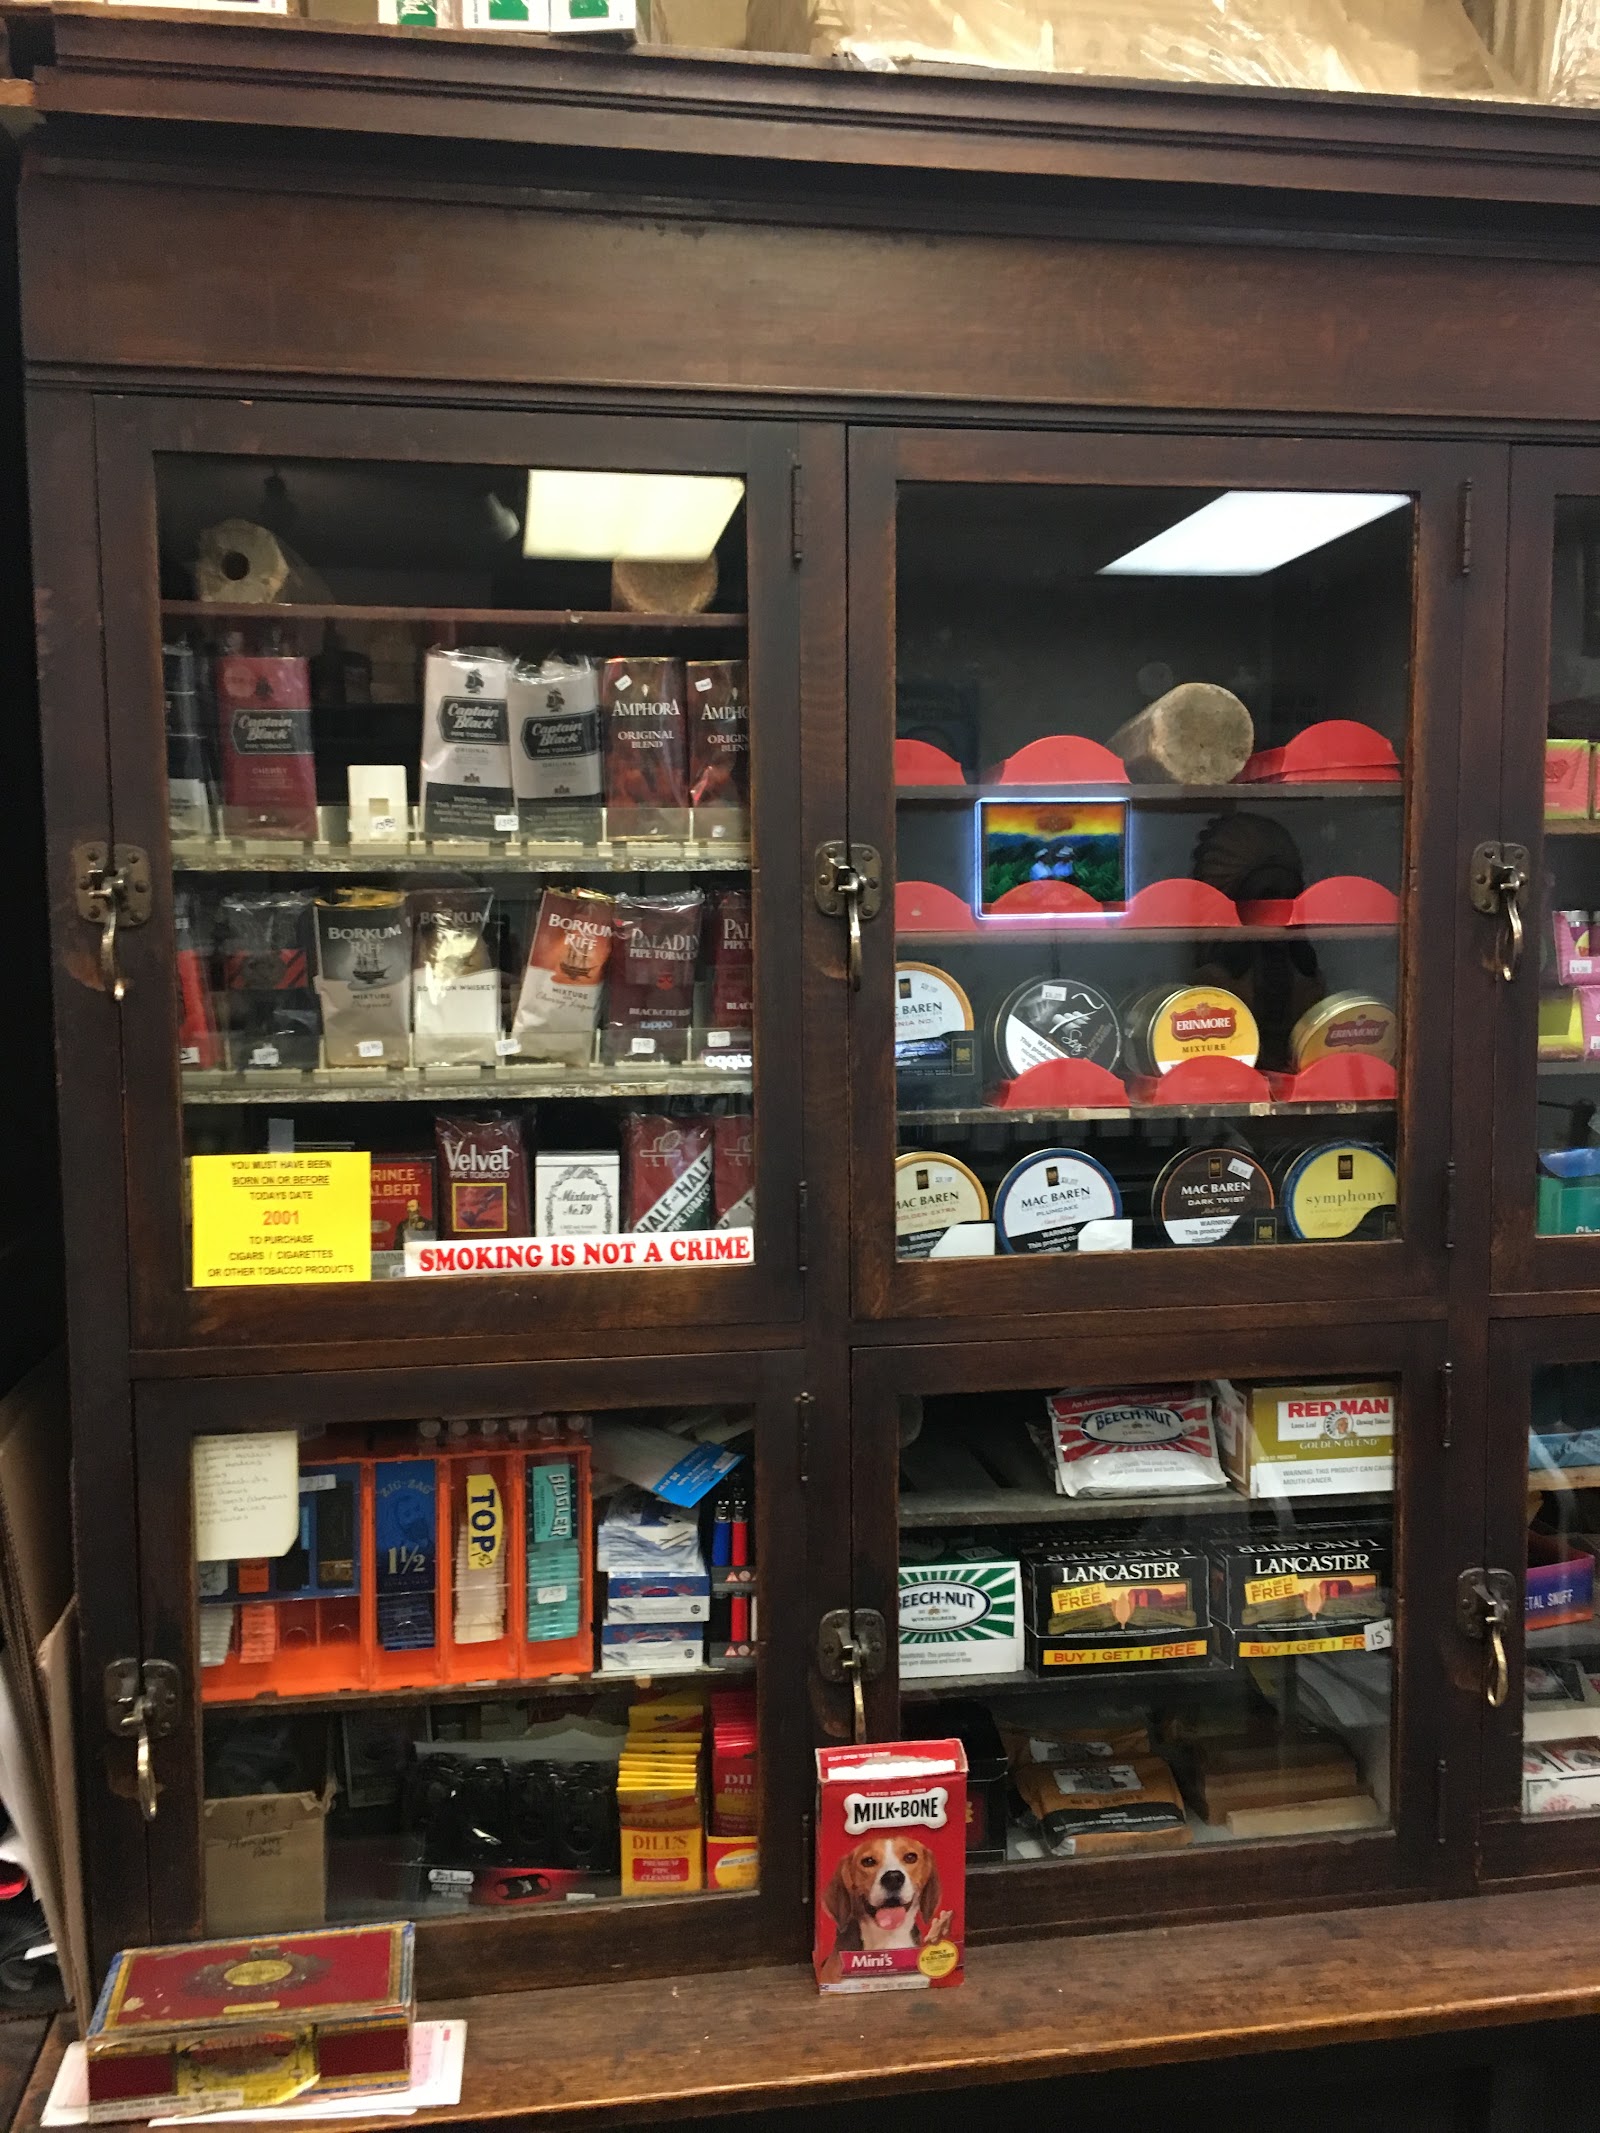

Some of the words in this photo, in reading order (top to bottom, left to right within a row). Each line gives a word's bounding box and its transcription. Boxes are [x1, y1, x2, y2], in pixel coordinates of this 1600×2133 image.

[447, 702, 501, 718] Captain
[611, 698, 681, 717] AMPHORA
[238, 713, 293, 730] Captain
[452, 715, 495, 730] Black
[531, 720, 584, 736] Captain
[245, 726, 290, 741] Black
[540, 732, 580, 747] Black
[617, 730, 675, 741] ORIGINAL
[631, 741, 664, 750] BLEND
[327, 924, 403, 941] BORKUM
[349, 940, 384, 953] RIFF
[563, 932, 599, 951] RIFF
[723, 940, 745, 950] PIPE
[629, 948, 652, 959] PIPE
[551, 987, 589, 1000] MIXTURE
[901, 1001, 943, 1015] BAREN
[1176, 1017, 1231, 1031] ERINMORE
[1330, 1027, 1379, 1039] ERINMORE
[1181, 1043, 1227, 1054] MIXTURE
[443, 1140, 512, 1172] Velvet
[231, 1161, 250, 1170] YOU
[252, 1160, 278, 1170] MUST
[280, 1160, 304, 1169] HAVE
[307, 1160, 332, 1169] BEEN
[232, 1176, 259, 1186] BORN
[260, 1176, 275, 1185] ON
[277, 1176, 291, 1185] OR
[293, 1175, 330, 1184] BEFORE
[371, 1168, 416, 1181] RINCE
[450, 1171, 469, 1179] PIPE
[469, 1171, 510, 1179] TOBACCO
[249, 1191, 287, 1200] TODAYS
[289, 1191, 313, 1200] DATE
[561, 1189, 600, 1202] Mixture
[636, 1197, 674, 1233] HALF
[675, 1156, 711, 1197] HALF
[1180, 1184, 1209, 1196] MAC
[1210, 1181, 1251, 1193] BAREN
[682, 1183, 711, 1222] TOBACCO
[920, 1191, 959, 1206] BAREN
[1021, 1195, 1048, 1209] MAC
[1051, 1186, 1091, 1203] BAREN
[1187, 1198, 1215, 1206] DARK
[1216, 1195, 1246, 1204] TWIST
[1305, 1188, 1386, 1209] symphony
[262, 1210, 299, 1226] 2001
[931, 1207, 957, 1216] EXTRA
[1036, 1204, 1079, 1217] PLUMCAKE
[249, 1236, 262, 1245] TO
[264, 1234, 314, 1244] PURCHASE
[1198, 1228, 1224, 1237] product
[229, 1251, 265, 1261] CIGARS
[276, 1249, 334, 1260] CIGARETTES
[420, 1245, 543, 1272] SMOKING
[550, 1244, 575, 1266] IS
[583, 1242, 636, 1265] NOT
[643, 1242, 663, 1262] A
[670, 1236, 750, 1261] CRIME
[207, 1268, 222, 1278] OR
[223, 1267, 256, 1277] OTHER
[258, 1266, 303, 1276] TOBACCO
[305, 1264, 354, 1274] PRODUCTS
[1288, 1401, 1337, 1418] RED
[1340, 1398, 1389, 1416] MAN
[1094, 1409, 1172, 1431] BEECH-NUT
[1299, 1440, 1341, 1450] GOLDEN
[1344, 1438, 1378, 1447] BLEND
[380, 1478, 432, 1497] ZIG-ZAG
[1283, 1477, 1306, 1486] MOUTH
[548, 1473, 570, 1538] BUGLER
[471, 1488, 496, 1553] TOP
[1254, 1553, 1371, 1574] LANCASTER
[1062, 1561, 1181, 1583] LANCASTER
[1251, 1582, 1295, 1601] FREE
[1547, 1589, 1574, 1606] SNUFF
[899, 1591, 976, 1609] EECH-NUT
[1058, 1592, 1103, 1611] FREE
[1053, 1652, 1086, 1663] BUY
[1102, 1650, 1134, 1661] GET
[1149, 1643, 1197, 1659] FREE
[1250, 1645, 1281, 1656] BUY
[1296, 1641, 1327, 1652] GET
[1341, 1636, 1366, 1649] FR
[632, 1834, 687, 1851] DILL'S
[851, 1953, 893, 1967] Mini's
